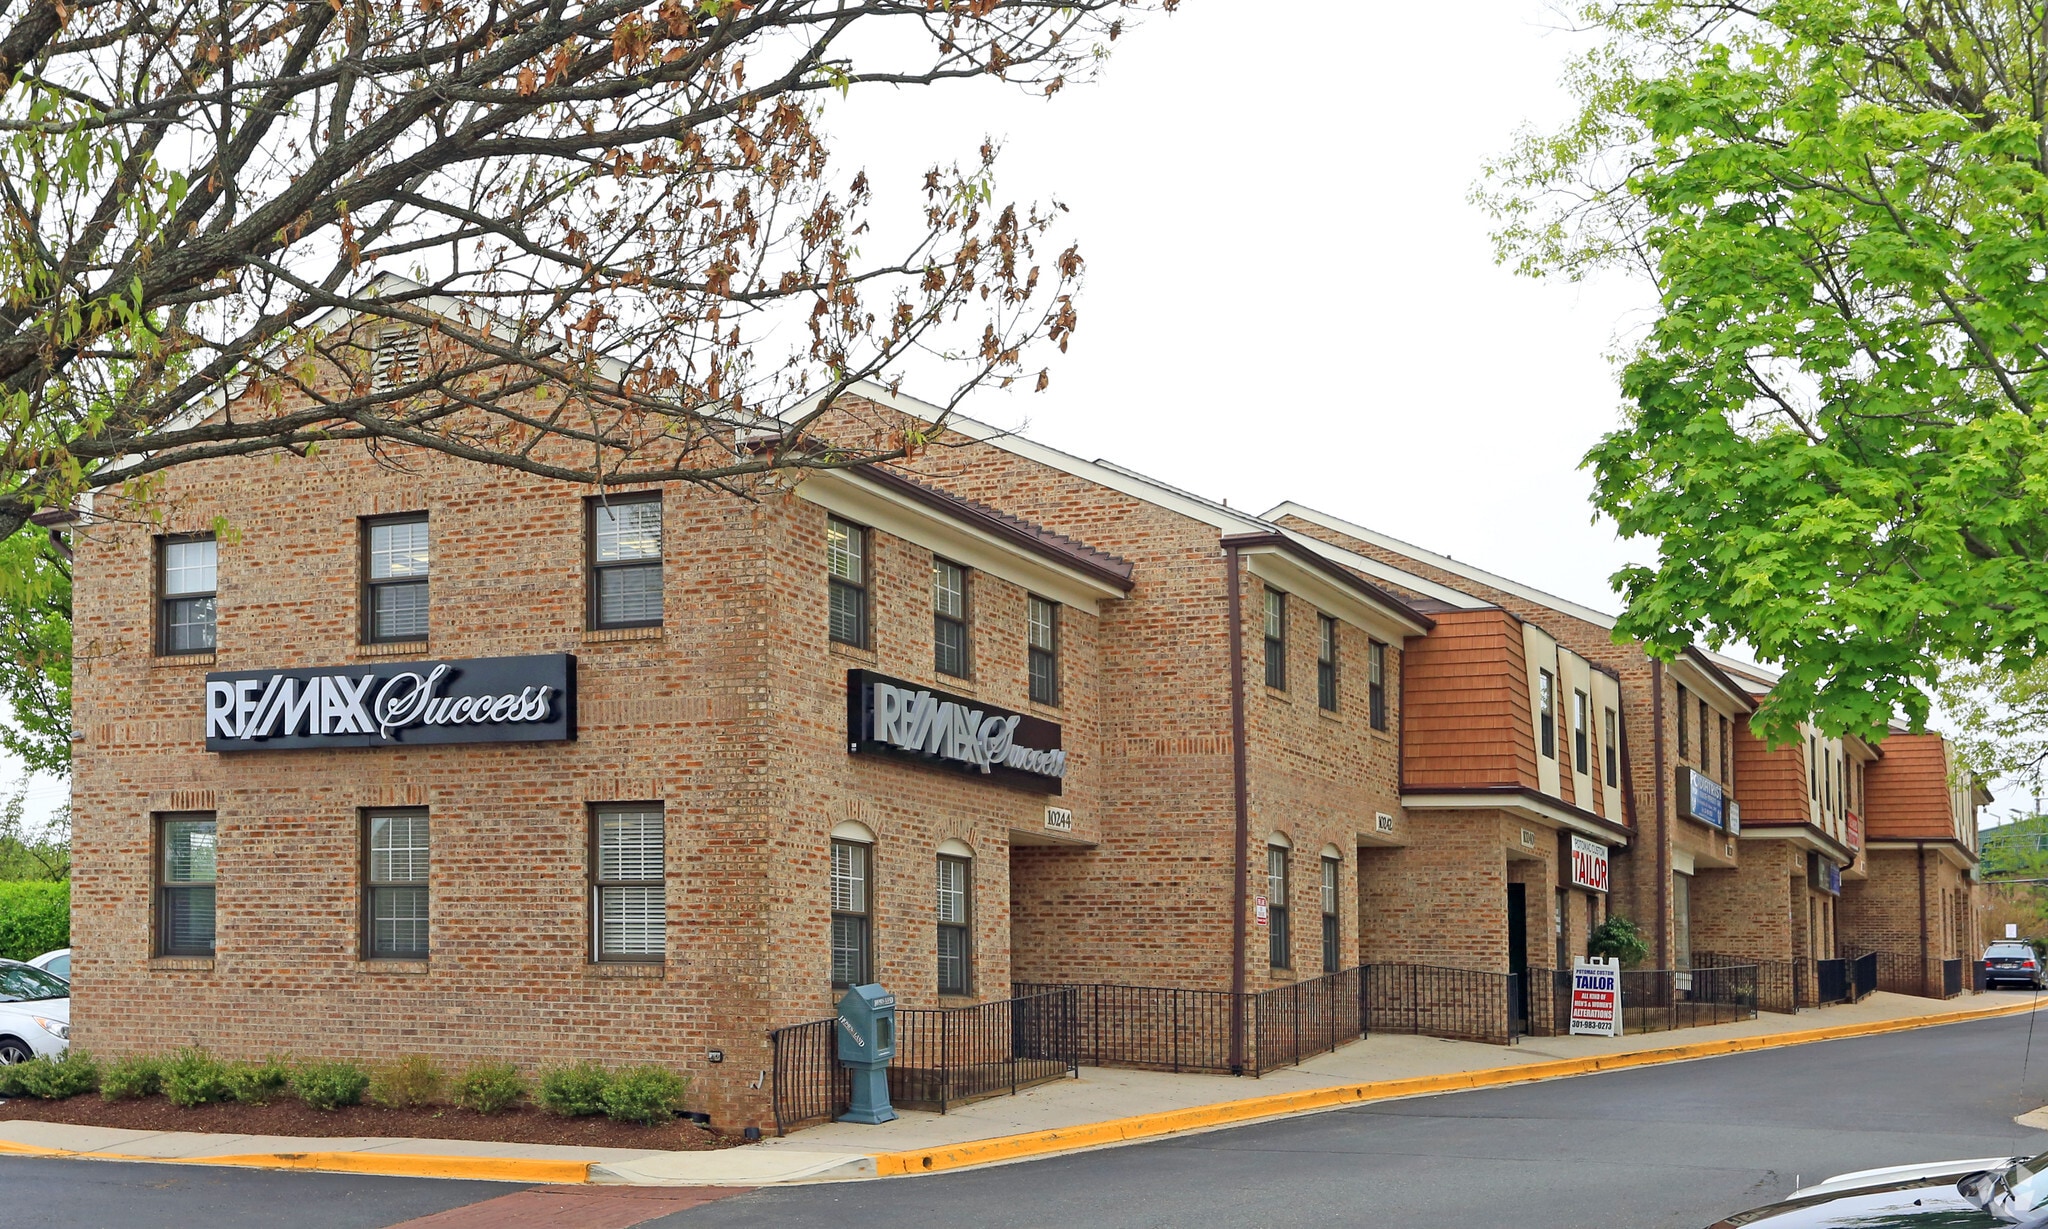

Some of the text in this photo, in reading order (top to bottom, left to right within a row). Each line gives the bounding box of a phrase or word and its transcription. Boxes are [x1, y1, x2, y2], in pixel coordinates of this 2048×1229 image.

[206, 663, 554, 741] RE/MAX Success
[874, 682, 1067, 778] RE/MAX Success
[1047, 809, 1072, 828] 10244
[1378, 815, 1393, 831] 10242
[1573, 850, 1608, 891] TAILOR
[1575, 975, 1614, 990] TAILOR
[1573, 1008, 1612, 1019] ALTERATIONS
[1571, 1020, 1612, 1030] 301-983-0273
